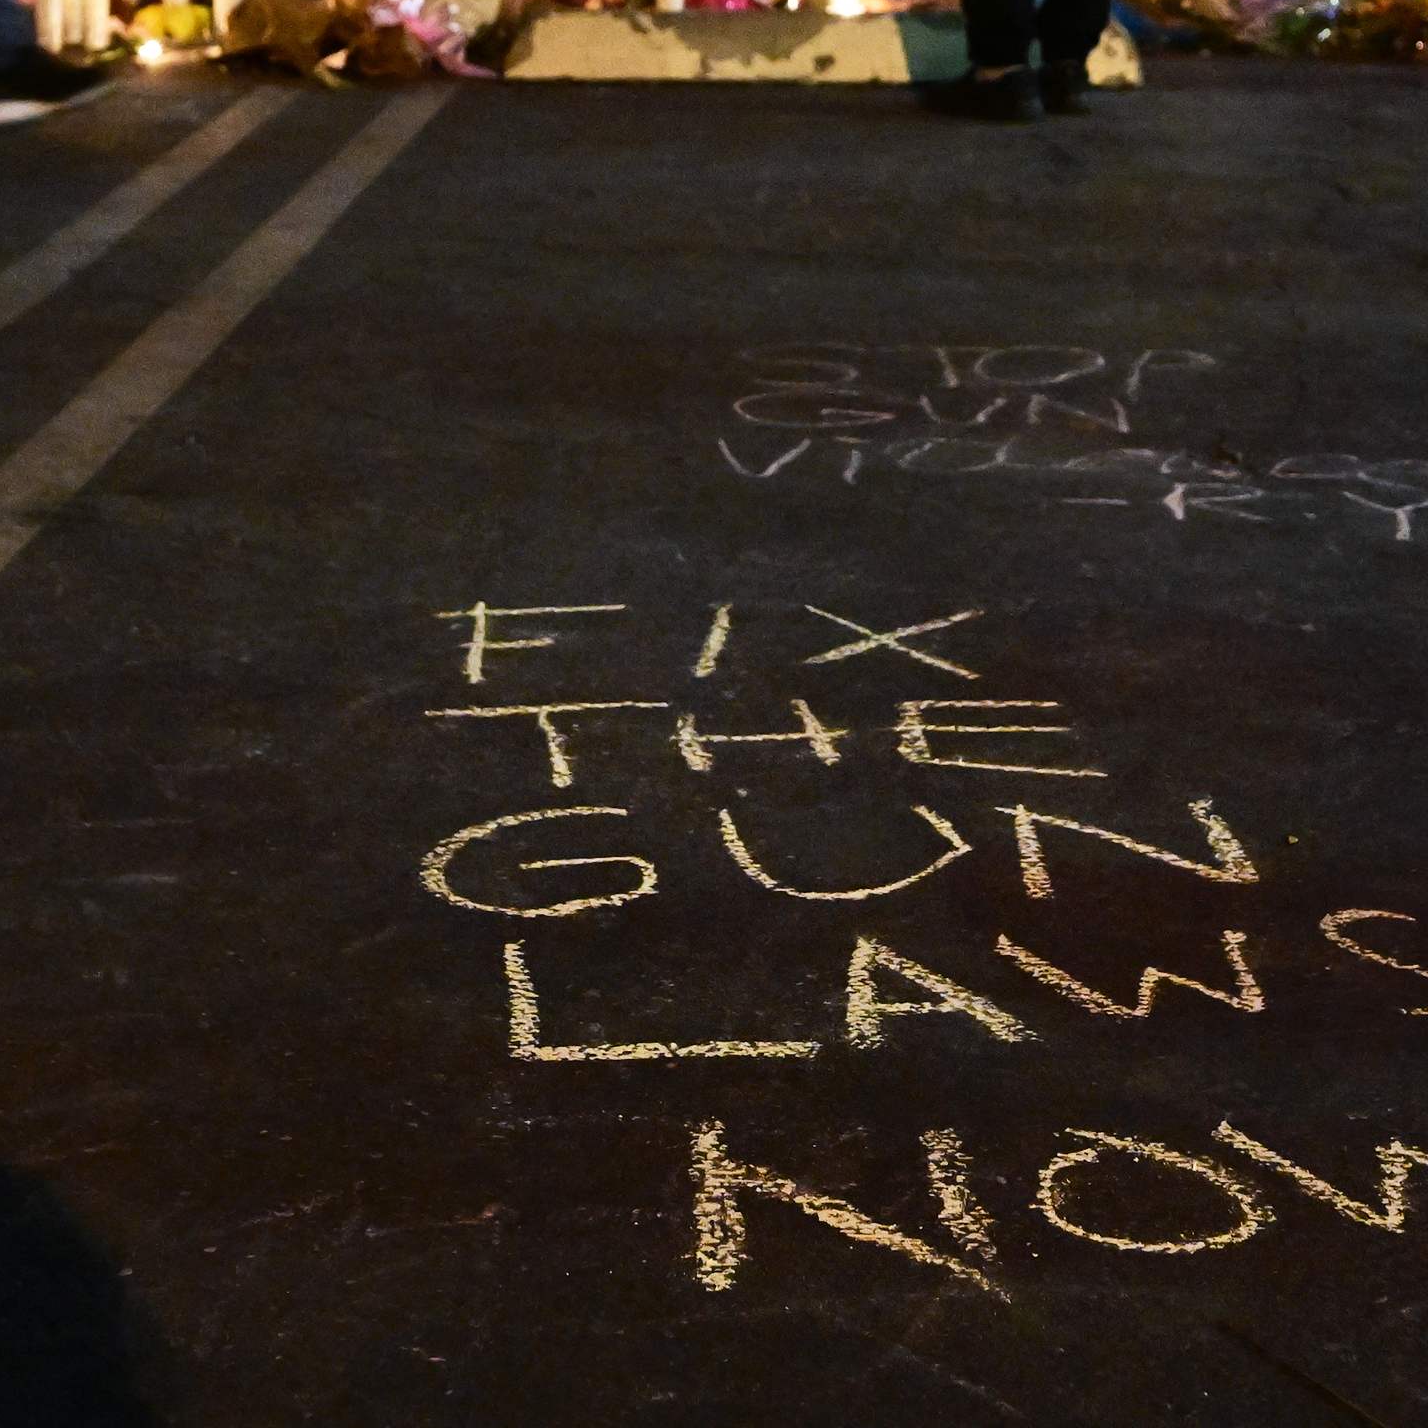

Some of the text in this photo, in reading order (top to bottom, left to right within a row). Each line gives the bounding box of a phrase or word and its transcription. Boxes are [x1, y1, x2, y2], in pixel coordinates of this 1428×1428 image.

[733, 389, 1131, 434] GUN
[435, 600, 983, 684] FIX
[424, 696, 1109, 788] THE
[419, 794, 1260, 919] GUN
